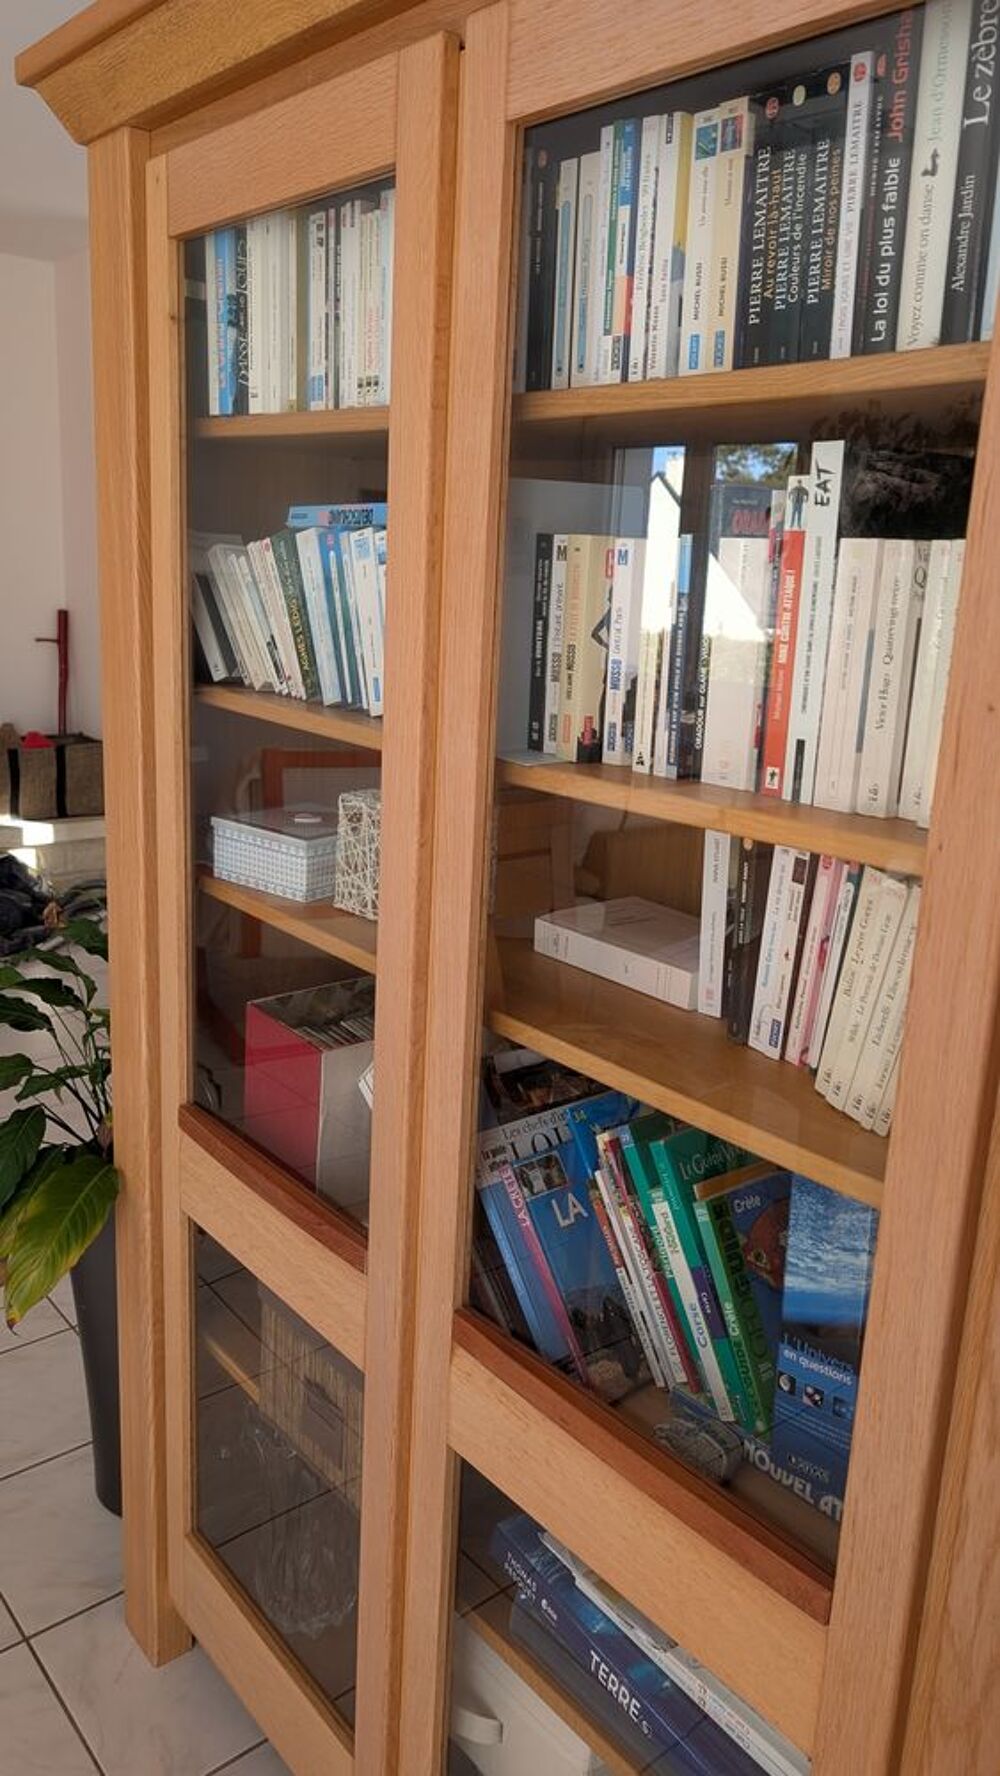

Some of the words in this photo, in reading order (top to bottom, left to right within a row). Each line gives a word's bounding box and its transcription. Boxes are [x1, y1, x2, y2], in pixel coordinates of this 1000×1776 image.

[892, 8, 914, 84] Grisha
[971, 0, 1000, 79] zèbre
[887, 90, 907, 144] John
[928, 104, 944, 143] Jean
[963, 85, 992, 129] Le
[850, 101, 866, 162] LEMAITRE
[795, 153, 808, 222] l'incendie
[811, 138, 830, 236] LEMAITRE
[830, 148, 842, 201] peines
[847, 164, 861, 212] PIERRE
[884, 157, 901, 214] faible
[753, 146, 771, 251] LEMAITRE
[768, 169, 782, 234] là-haut
[778, 148, 796, 245] LEMAITRE
[922, 183, 934, 230] danse
[960, 174, 977, 219] Jardin
[793, 227, 803, 243] de
[827, 205, 837, 230] nos
[879, 217, 896, 256] plus
[765, 236, 777, 281] revoir
[825, 231, 834, 247] de
[919, 232, 928, 253] on
[952, 222, 971, 292] Alexandre
[763, 282, 773, 299] Au
[774, 246, 790, 311] PIERRE
[787, 246, 802, 303] Couleurs
[806, 239, 823, 304] PIERRE
[821, 250, 834, 291] Miroir
[876, 263, 891, 285] du
[913, 253, 926, 309] comme
[749, 258, 764, 325] PIERRE
[874, 287, 887, 315] loi
[871, 322, 886, 342] La
[907, 311, 925, 347] Voyez
[814, 466, 836, 507] EAT
[557, 545, 567, 562] M
[618, 550, 628, 565] M
[615, 606, 624, 622] Park
[567, 643, 577, 674] MUSSO
[613, 624, 624, 655] Central
[778, 644, 788, 665] MIKE
[551, 652, 562, 682] MUSSO
[610, 659, 622, 691] MUSSO
[880, 672, 891, 701] Hugo
[695, 707, 705, 750] ORADOUR
[876, 703, 887, 731] Victor
[516, 1209, 530, 1227] LA
[553, 1193, 589, 1228] LA
[733, 1194, 761, 1214] Crète
[699, 1290, 714, 1314] Corse
[720, 1300, 741, 1337] Crète
[651, 1304, 678, 1357] FLORENCE
[683, 1301, 711, 1349] Corse
[783, 1350, 797, 1363] en
[799, 1357, 854, 1387] questions
[784, 1333, 854, 1373] L'Univers
[742, 1438, 815, 1504] NOUVEL
[507, 1551, 538, 1592] THOMAS
